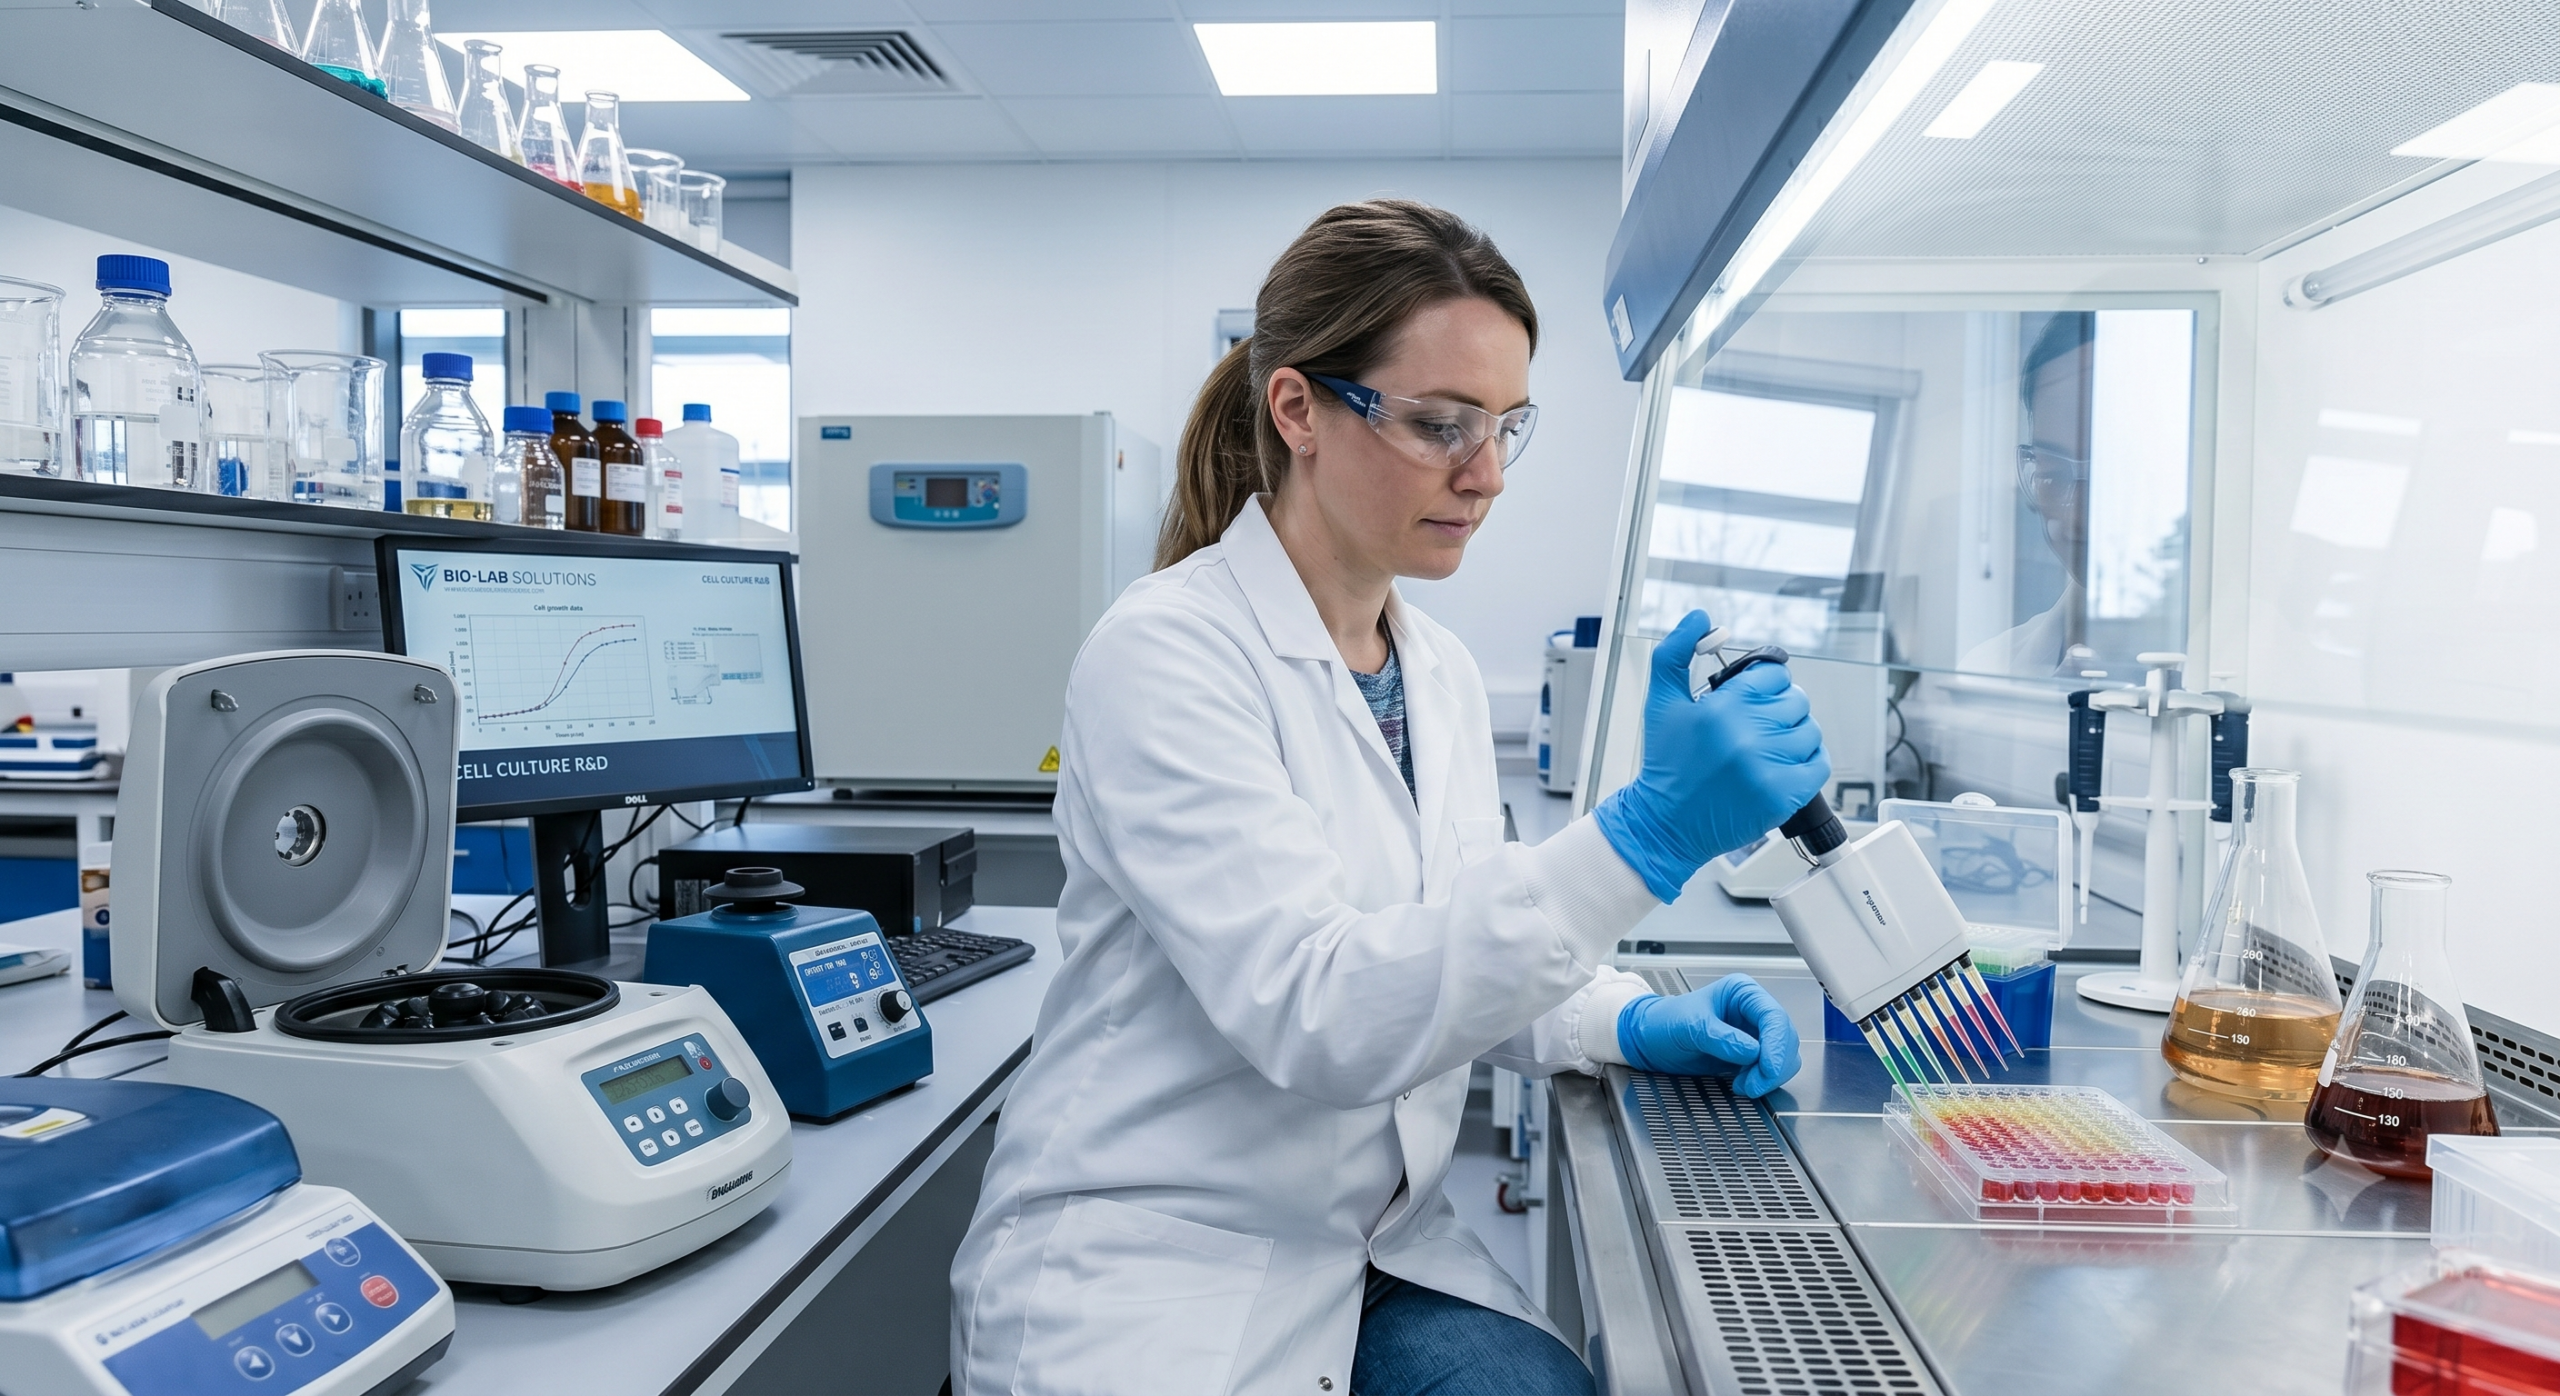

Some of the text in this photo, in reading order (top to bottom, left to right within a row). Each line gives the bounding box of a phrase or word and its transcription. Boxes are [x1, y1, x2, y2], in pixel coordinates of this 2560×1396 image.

[443, 569, 597, 587] BIO-LAB SOLUTIONS
[701, 575, 720, 584] CELL
[720, 576, 753, 585] CULTURE
[496, 757, 571, 777] CULTURE
[575, 755, 609, 772] R&D
[2386, 1054, 2407, 1067] 180
[2378, 1113, 2400, 1127] 130
